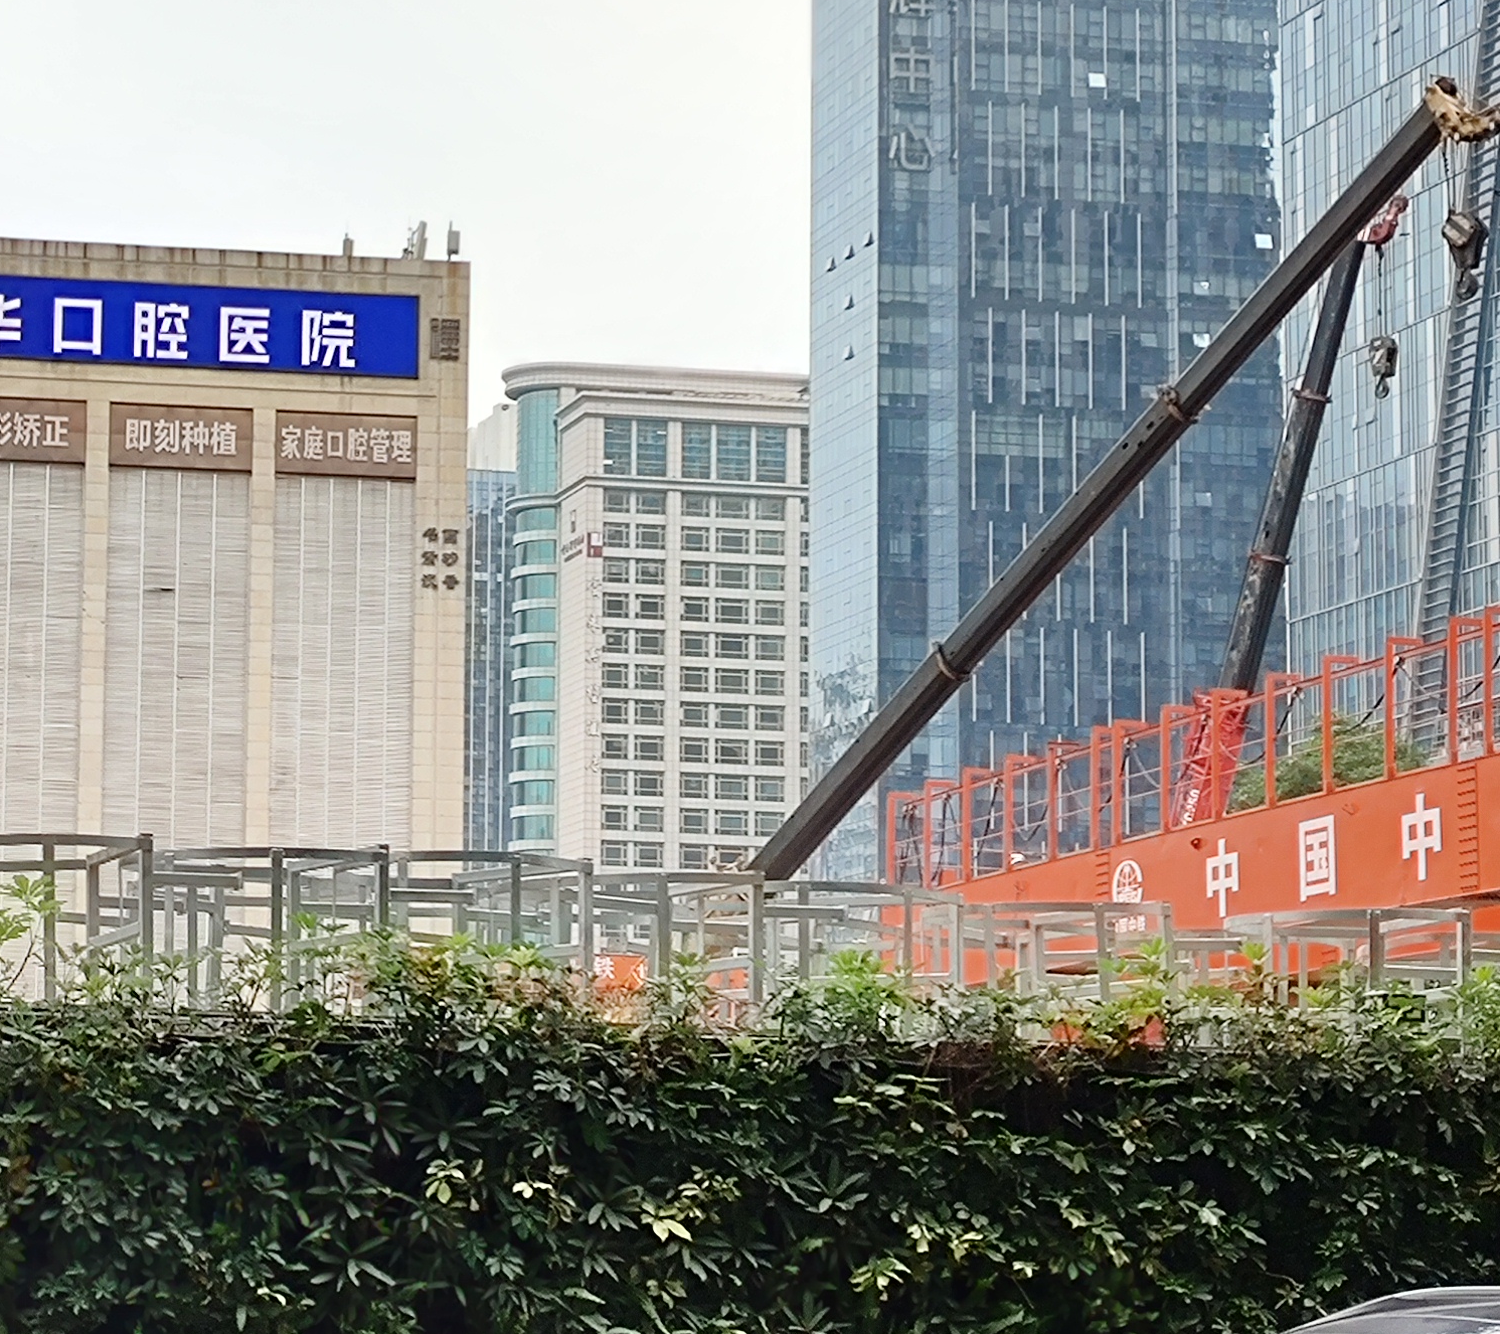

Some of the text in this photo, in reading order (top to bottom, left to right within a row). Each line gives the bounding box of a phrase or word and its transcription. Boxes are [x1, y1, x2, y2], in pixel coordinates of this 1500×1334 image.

[124, 418, 238, 457] 即刻种植
[280, 424, 412, 466] 家庭口腔管理
